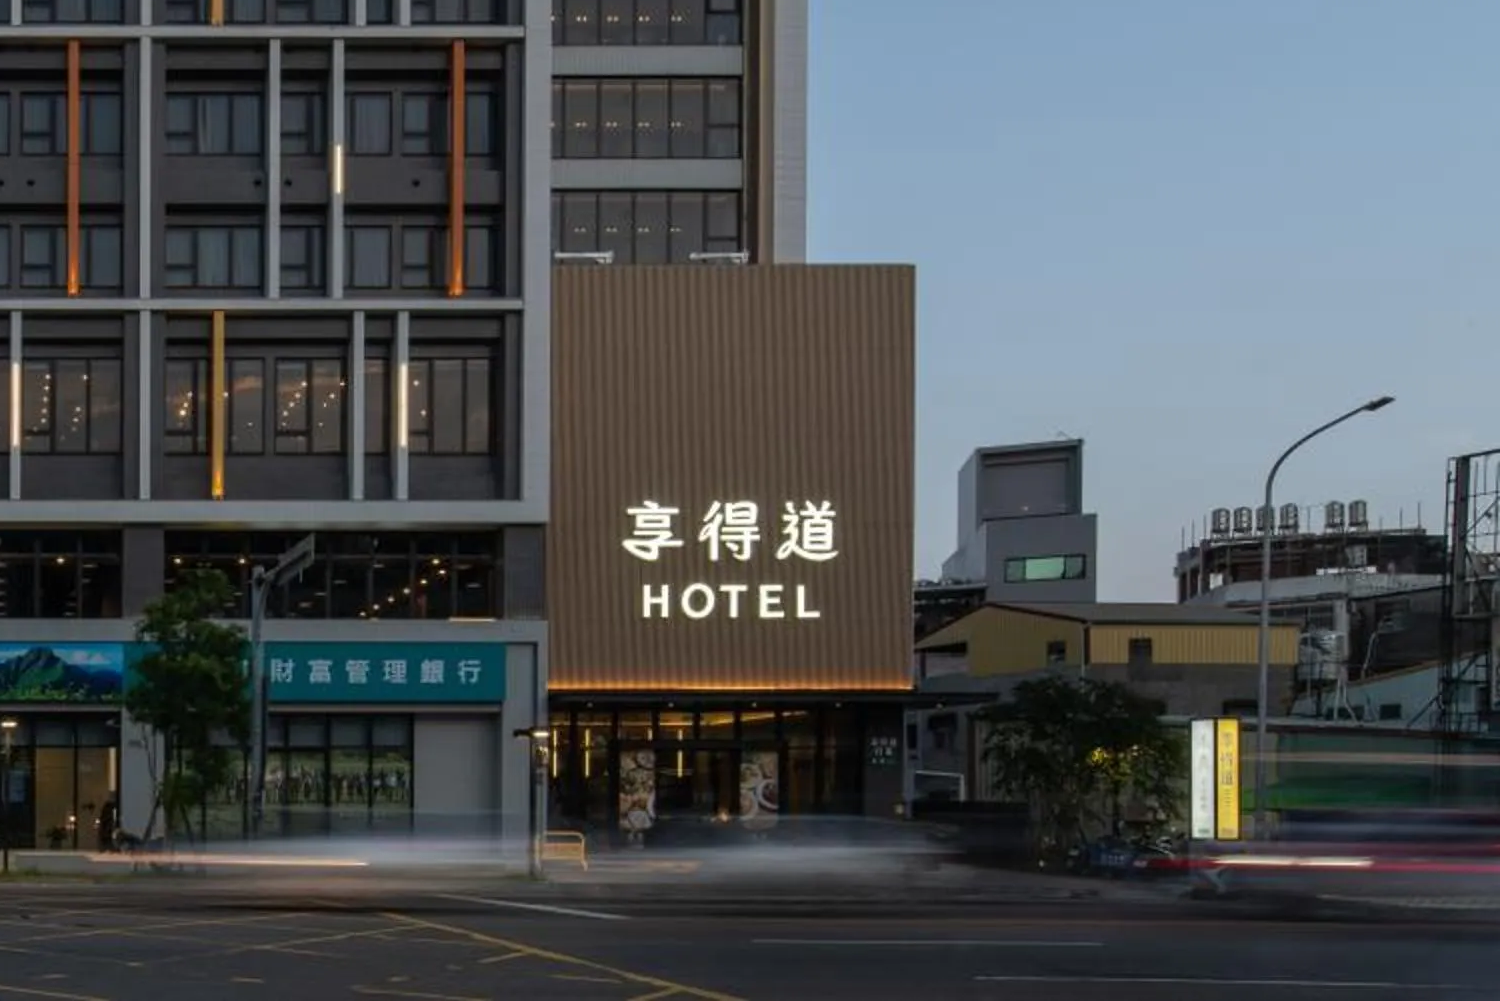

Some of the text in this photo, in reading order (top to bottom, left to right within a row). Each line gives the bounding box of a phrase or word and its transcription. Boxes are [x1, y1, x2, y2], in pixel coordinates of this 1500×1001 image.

[622, 500, 839, 561] 享得道
[642, 582, 821, 619] HOTEL
[270, 658, 482, 684] 財富管理銀行
